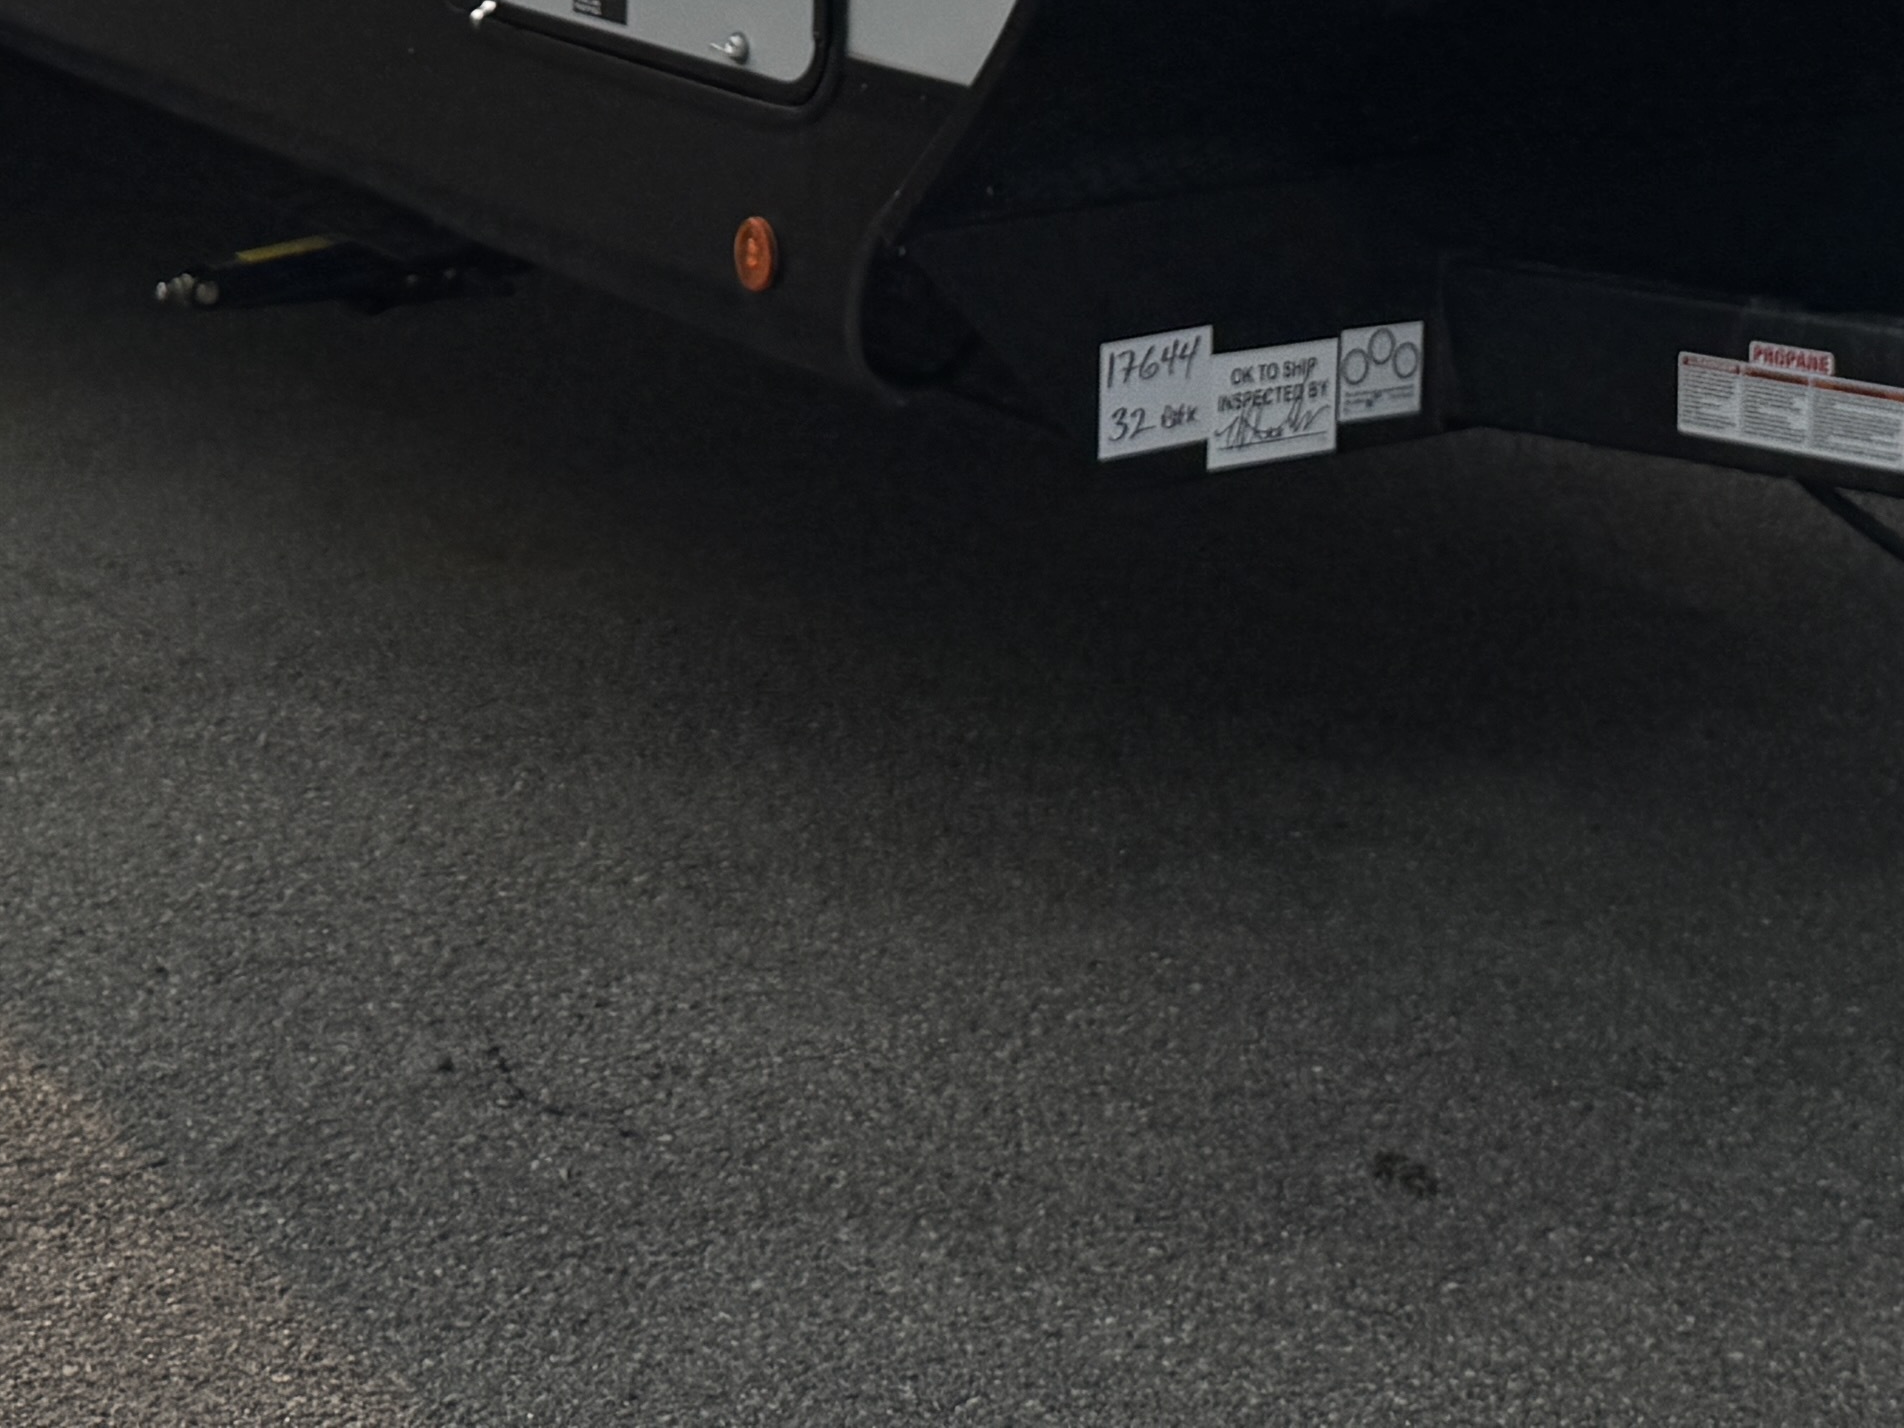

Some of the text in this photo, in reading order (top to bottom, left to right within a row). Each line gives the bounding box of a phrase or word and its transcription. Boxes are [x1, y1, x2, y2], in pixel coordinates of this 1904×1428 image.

[1107, 335, 1202, 389] 17644
[1230, 356, 1318, 385] OK TO SHIP
[1752, 345, 1830, 373] PROPANE
[1218, 383, 1304, 412] INSPECTED
[1308, 379, 1328, 399] BY
